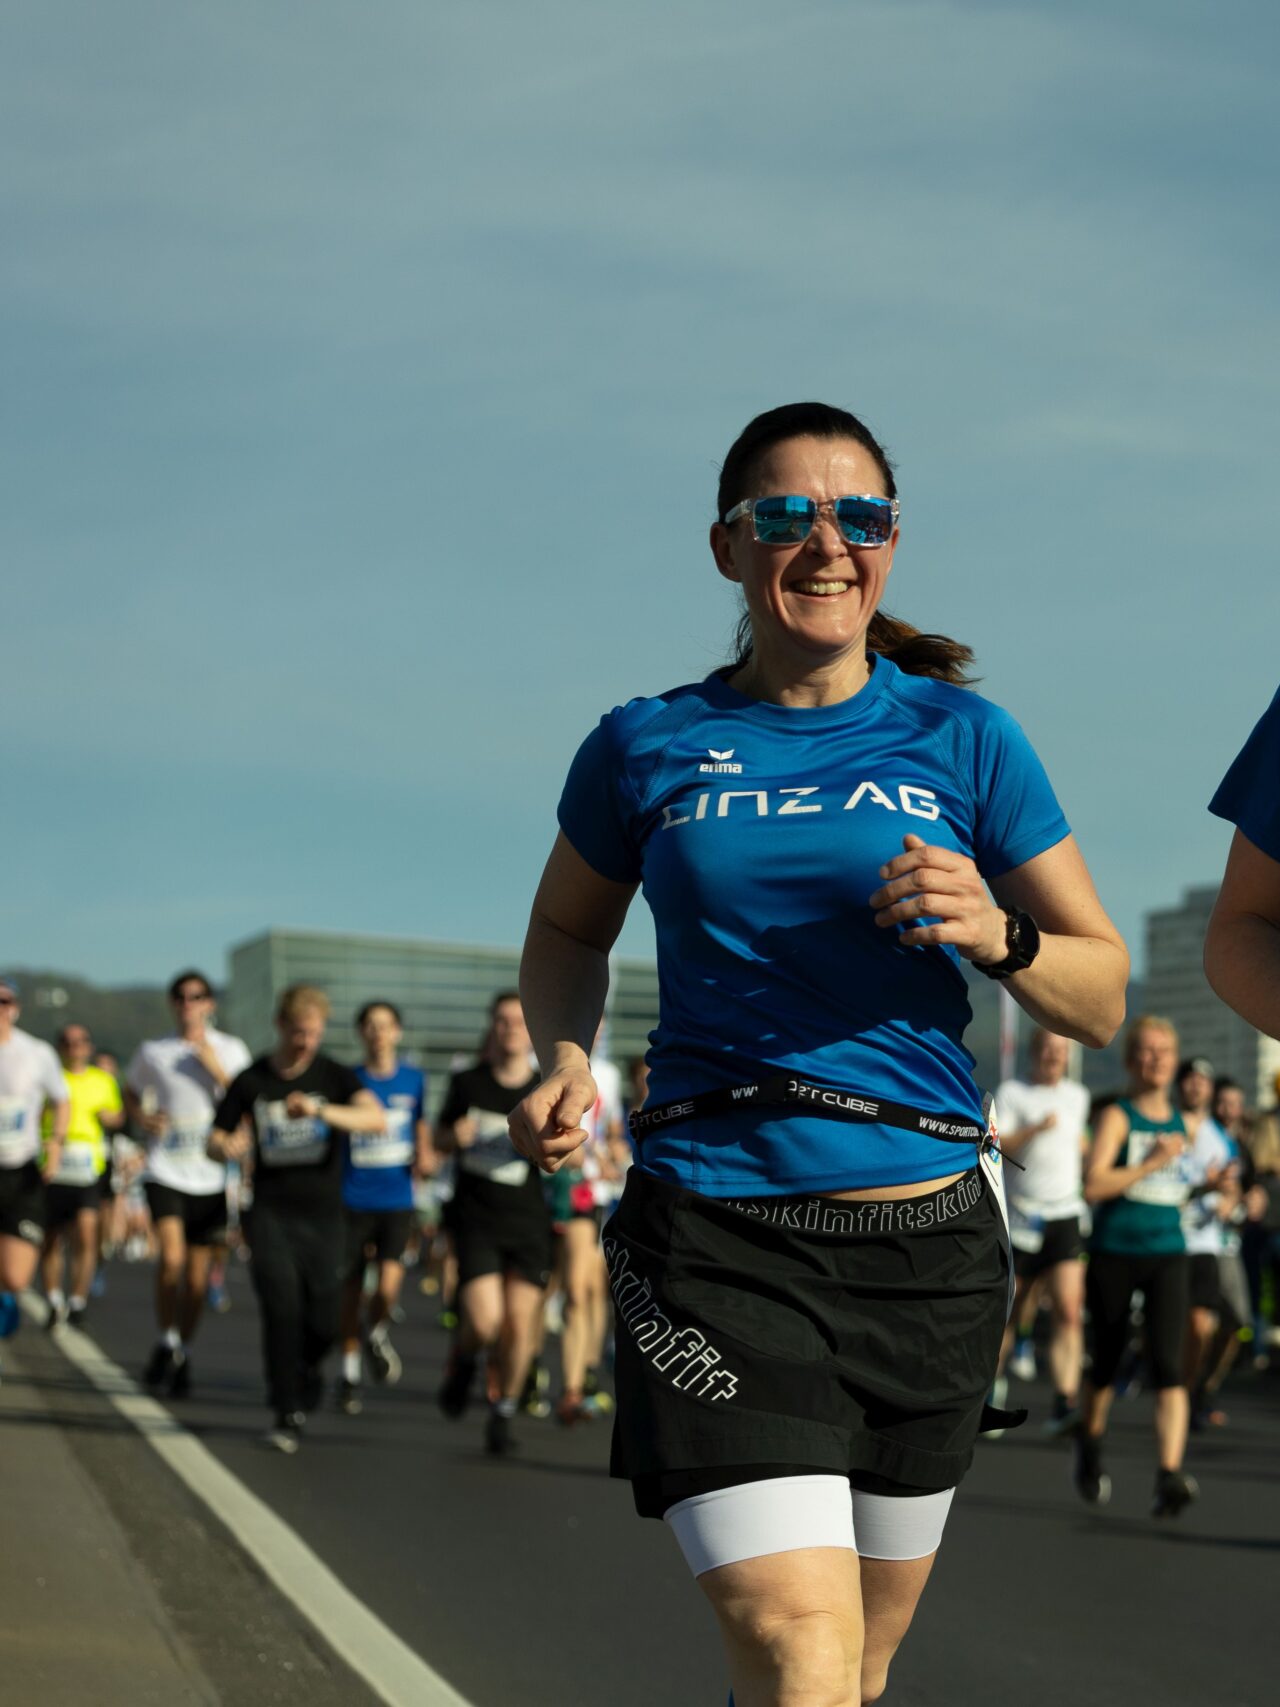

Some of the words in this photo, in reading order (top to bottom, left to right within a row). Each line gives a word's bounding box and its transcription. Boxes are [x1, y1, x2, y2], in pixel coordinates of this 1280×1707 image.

[700, 762, 742, 774] erima
[662, 786, 822, 830] LINZ
[844, 781, 940, 821] AG
